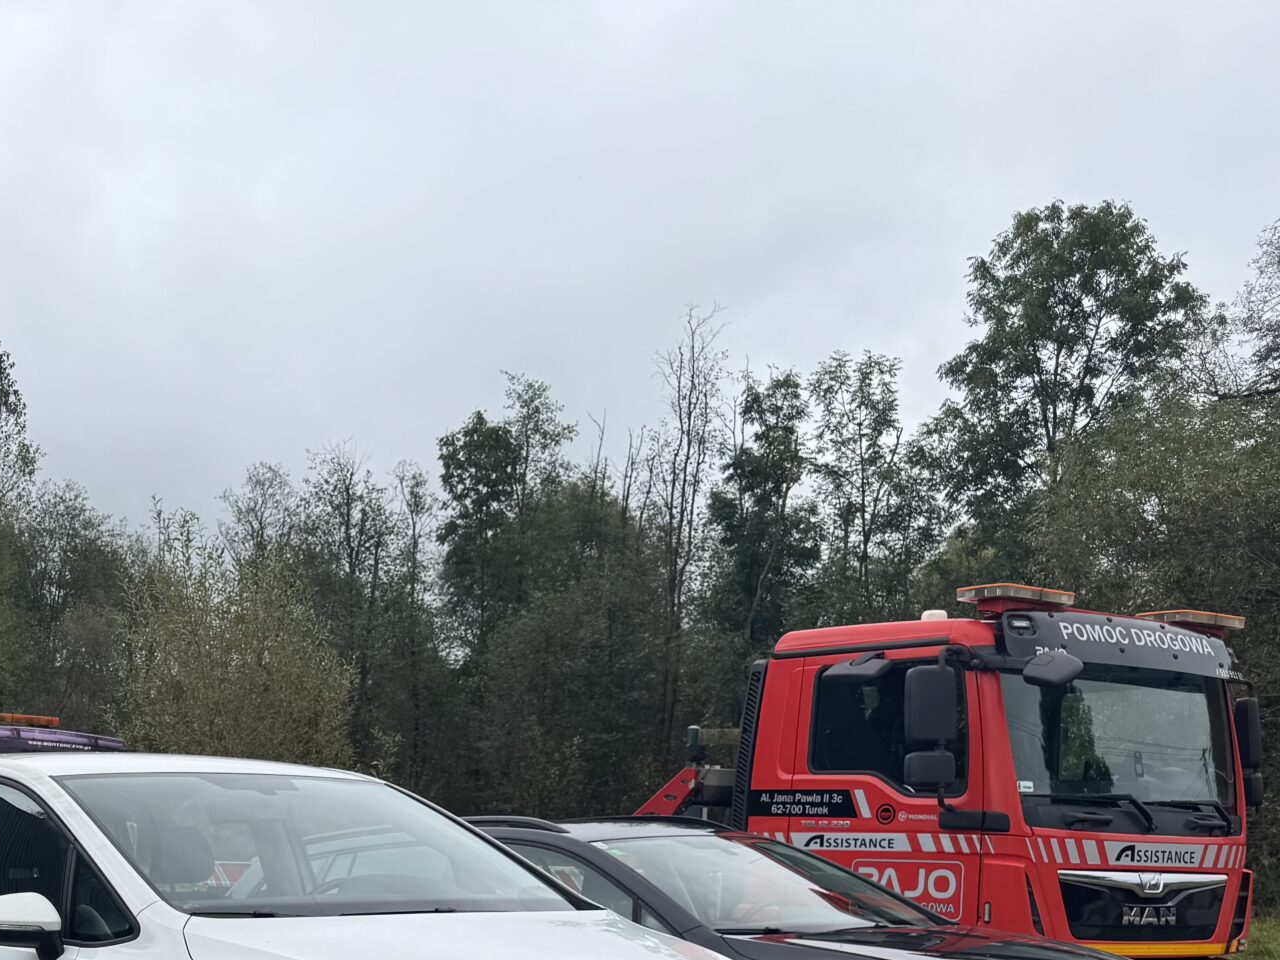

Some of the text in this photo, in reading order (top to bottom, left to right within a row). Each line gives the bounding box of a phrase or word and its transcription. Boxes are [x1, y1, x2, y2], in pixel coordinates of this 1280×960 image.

[1058, 621, 1215, 656] POMOC DROGOWA
[772, 793, 793, 802] Jana
[831, 793, 843, 803] 3c
[771, 804, 829, 814] 62-700 Turek
[803, 834, 895, 849] ASSISTANCE
[1115, 844, 1195, 864] ASSISTANCE
[1122, 907, 1176, 925] MAN
